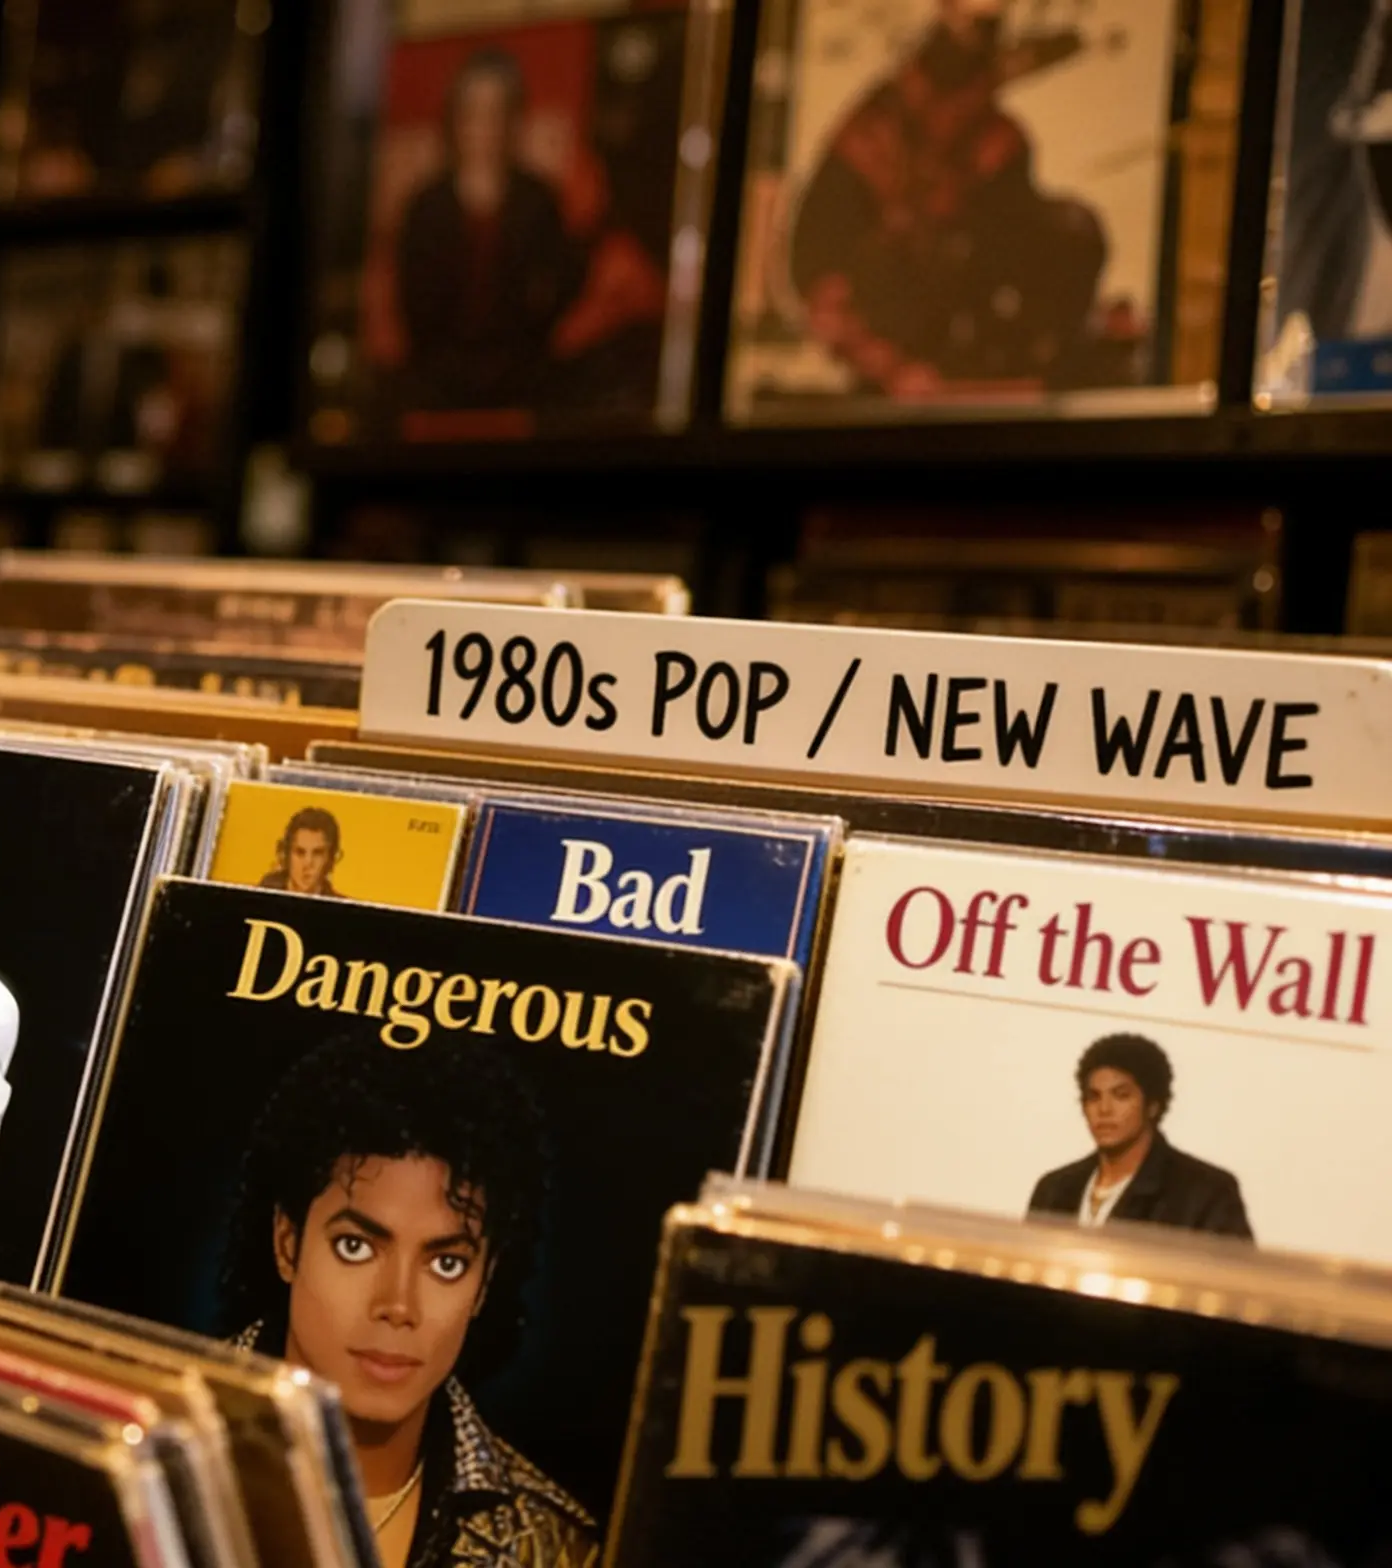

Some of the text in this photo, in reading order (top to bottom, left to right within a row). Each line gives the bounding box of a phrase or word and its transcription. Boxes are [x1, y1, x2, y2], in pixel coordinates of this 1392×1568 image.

[423, 628, 618, 733] 1980s
[651, 650, 790, 745] POP
[806, 657, 863, 760] /
[884, 672, 1059, 769] NEW
[1090, 687, 1322, 791] WAVE
[549, 838, 712, 937] Bad
[886, 887, 1376, 1027] Off the Wall
[226, 917, 654, 1060] Dangerous
[666, 1305, 1180, 1537] History
